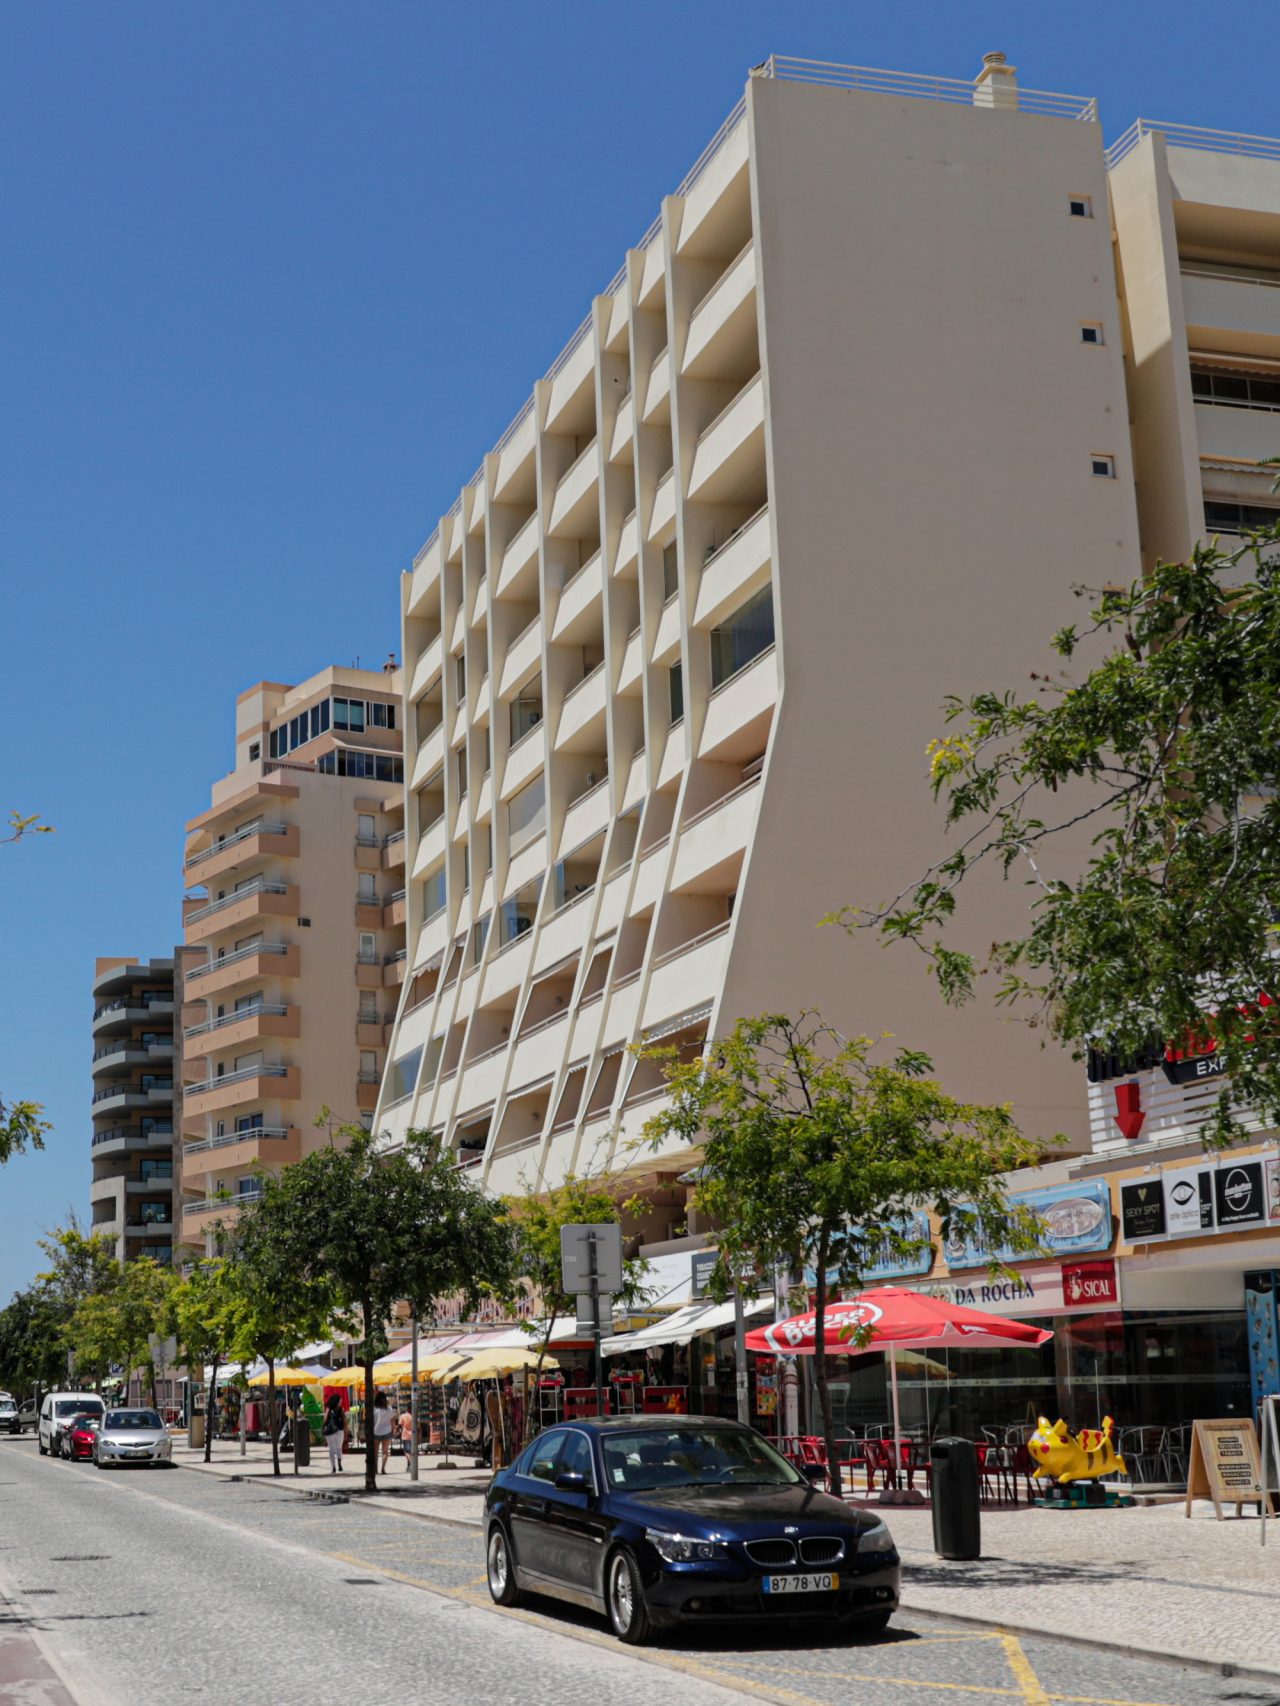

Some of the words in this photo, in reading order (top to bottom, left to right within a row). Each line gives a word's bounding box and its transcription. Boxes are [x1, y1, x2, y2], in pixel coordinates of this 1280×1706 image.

[1125, 1207, 1144, 1219] SEXY
[1144, 1203, 1161, 1216] SPOT
[955, 1288, 977, 1305] DA
[981, 1281, 1035, 1304] ROCHA
[1082, 1279, 1112, 1298] SICAL
